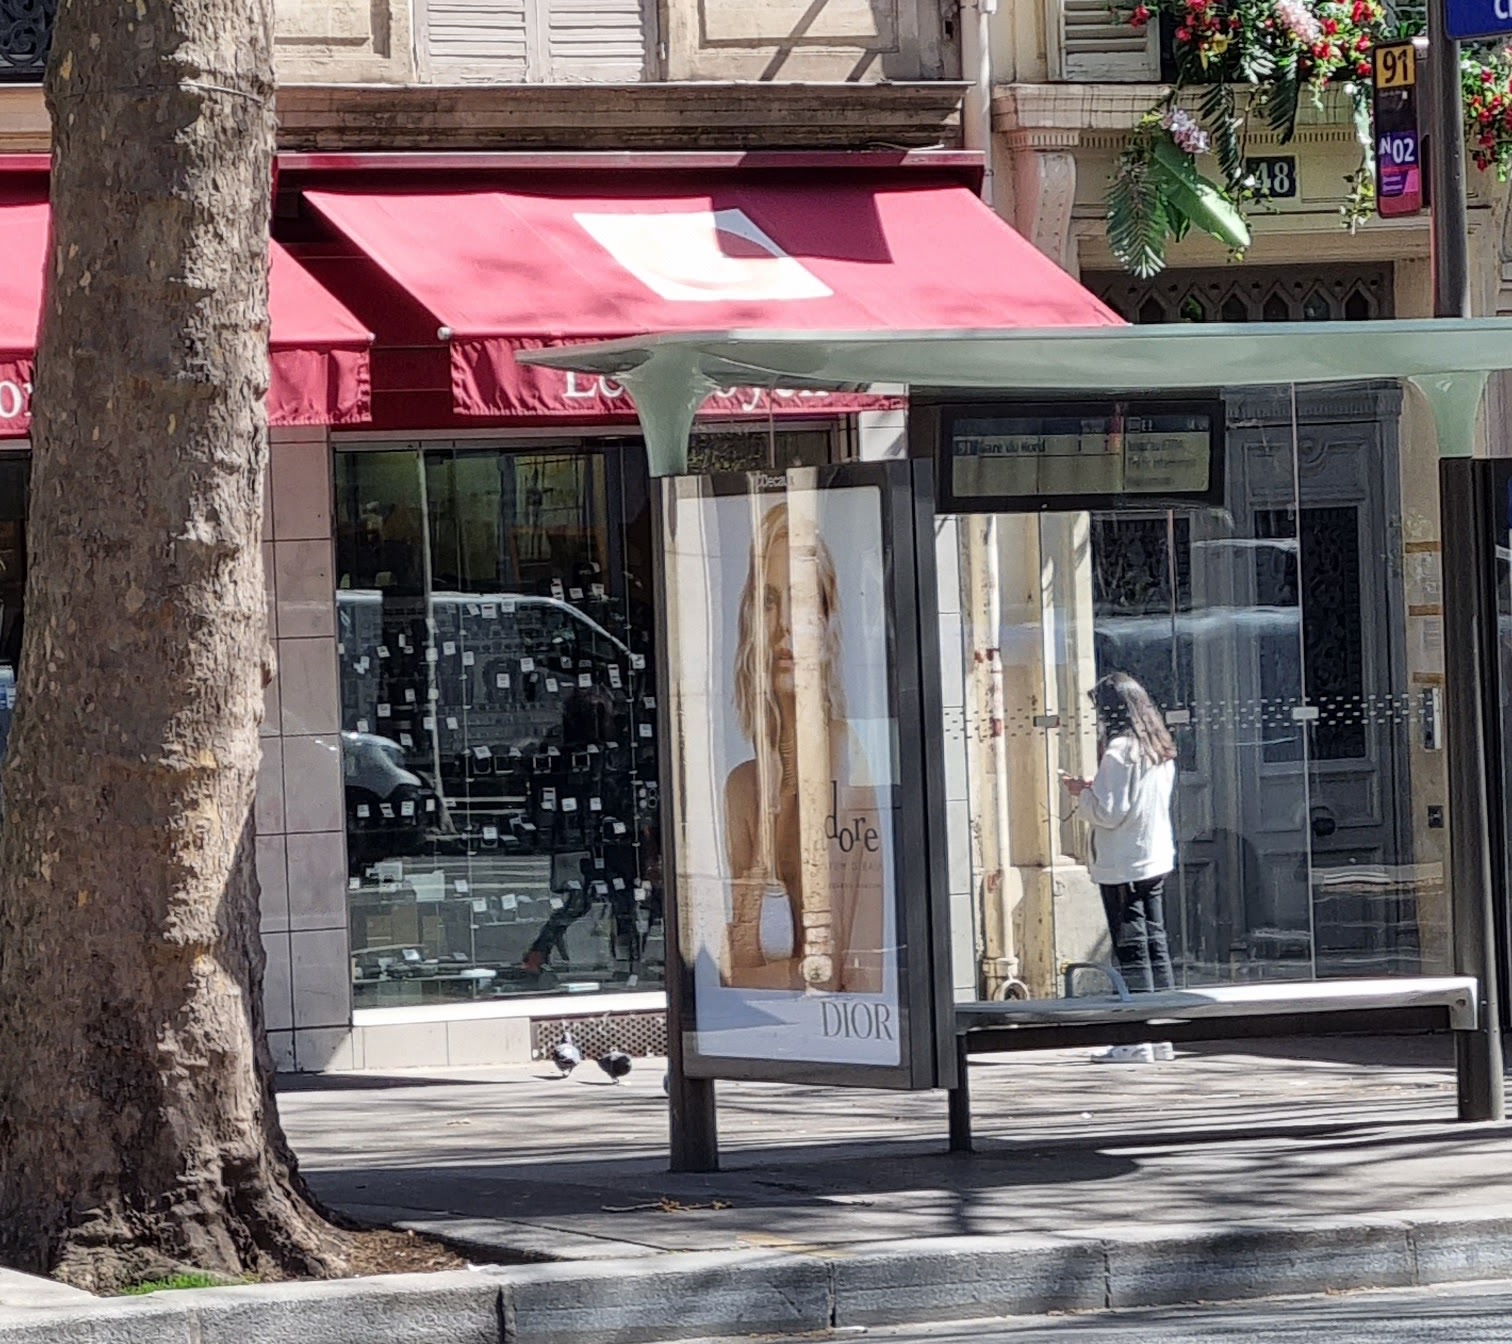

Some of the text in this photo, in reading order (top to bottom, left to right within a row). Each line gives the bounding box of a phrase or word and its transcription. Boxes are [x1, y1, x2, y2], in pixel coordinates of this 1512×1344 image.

[1382, 49, 1408, 84] 91
[1252, 161, 1290, 194] 48
[821, 1001, 894, 1040] DIOR
